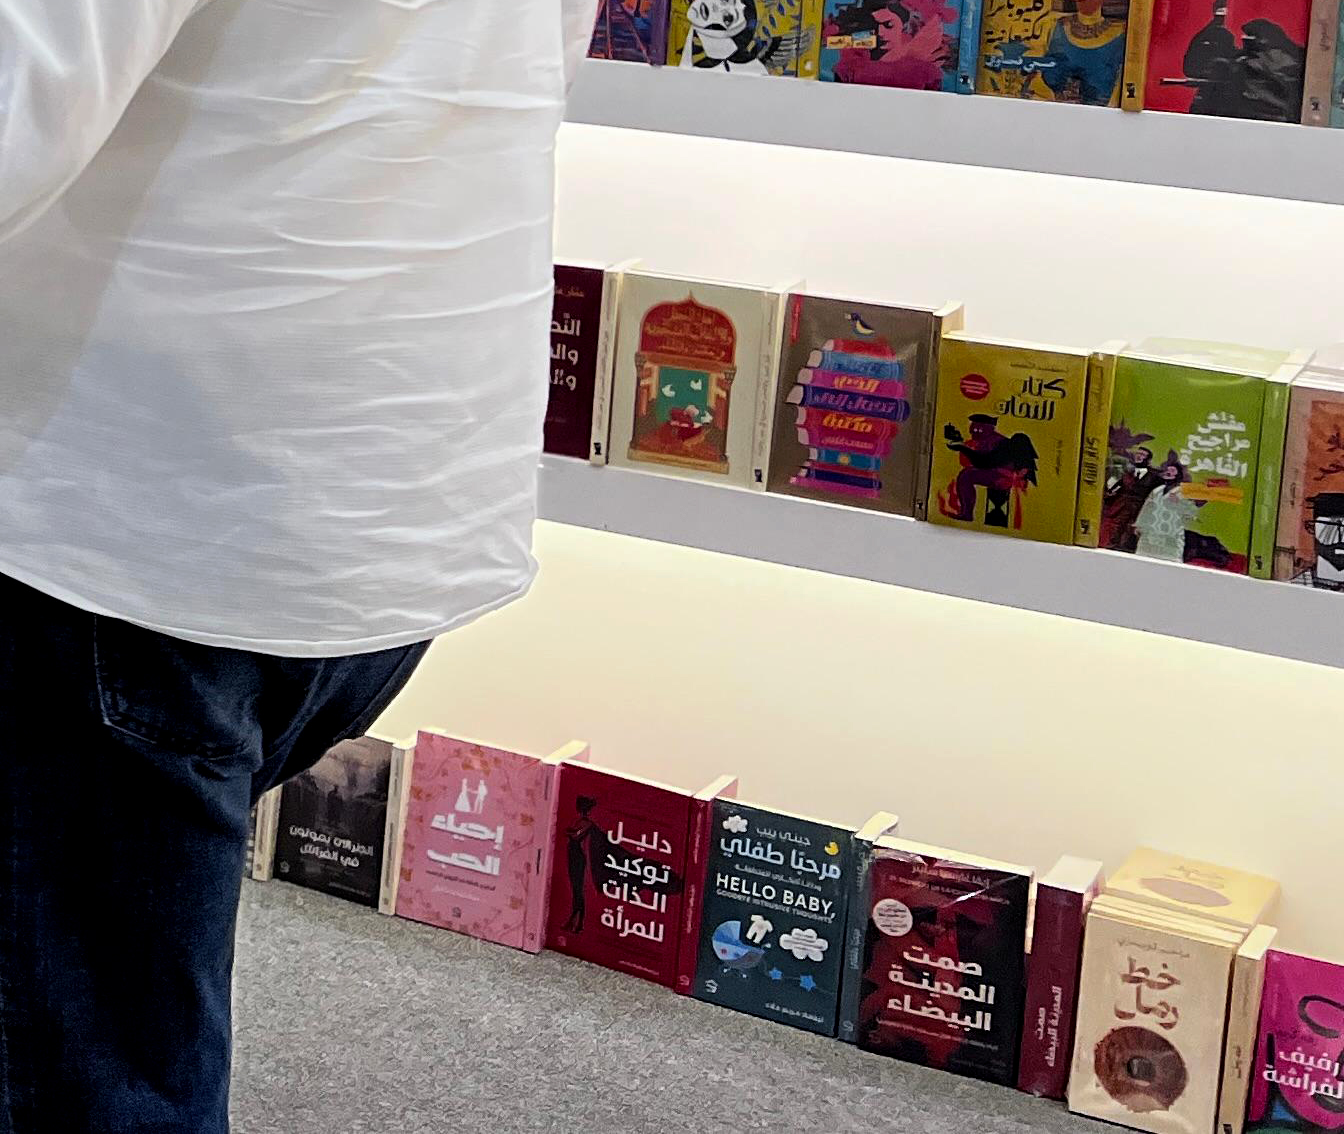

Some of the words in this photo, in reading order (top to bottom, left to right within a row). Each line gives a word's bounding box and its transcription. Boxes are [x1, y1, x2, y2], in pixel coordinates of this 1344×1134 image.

[430, 813, 504, 851] إحياء
[606, 821, 672, 854] دليل
[427, 849, 501, 877] الحب
[720, 837, 784, 866] طفلي
[604, 854, 670, 884] توكيد
[601, 880, 666, 913] الذات
[716, 873, 776, 899] HELLO
[783, 886, 836, 921] BABY,
[600, 909, 665, 943] للمرأة
[902, 946, 982, 976] صمت
[1124, 958, 1181, 991] خط
[888, 965, 995, 1005] المدينة
[887, 995, 991, 1032] البيضاء
